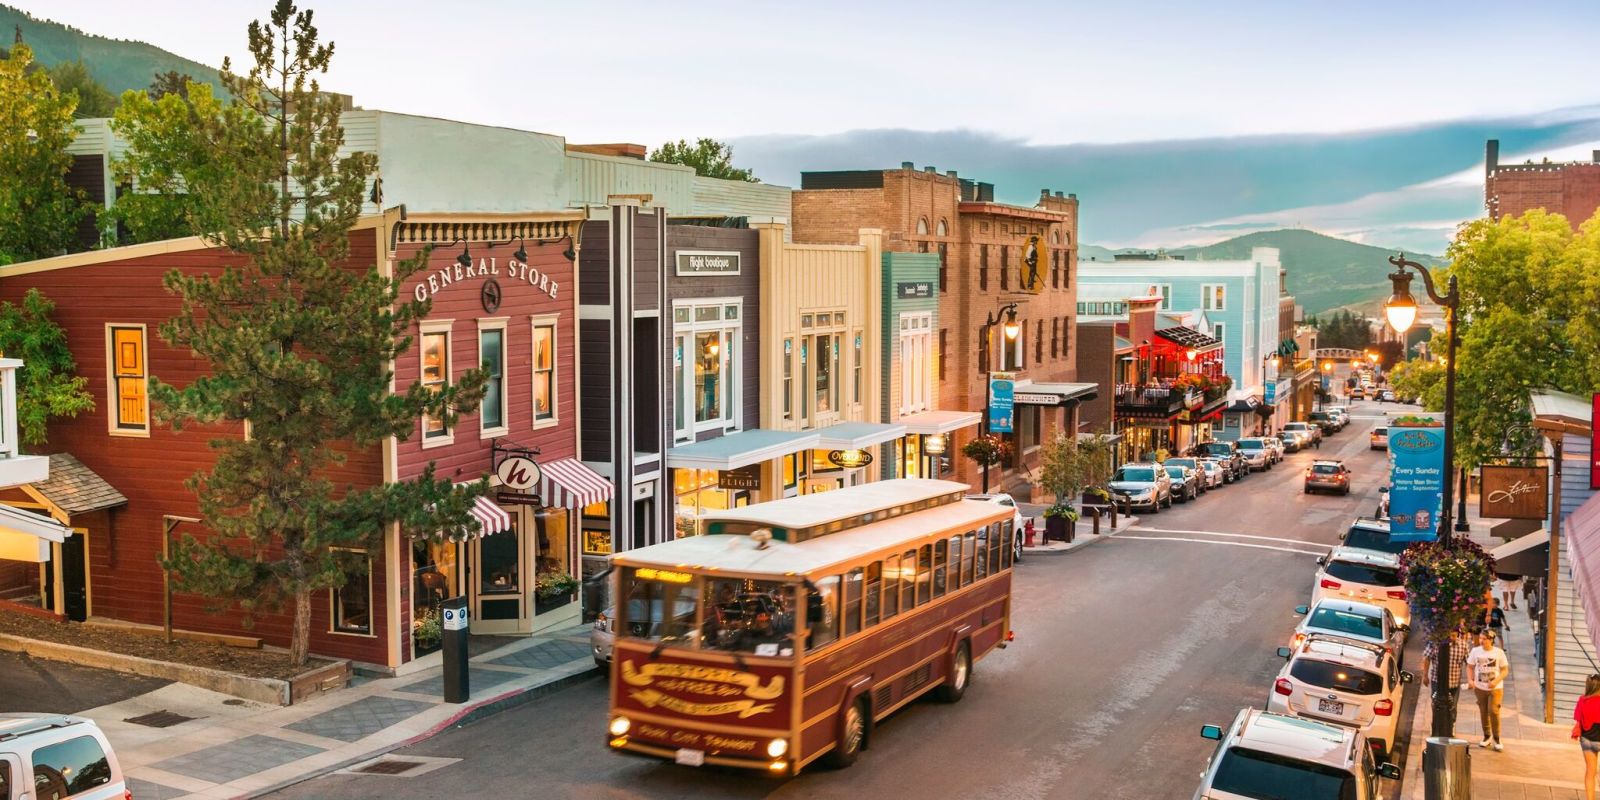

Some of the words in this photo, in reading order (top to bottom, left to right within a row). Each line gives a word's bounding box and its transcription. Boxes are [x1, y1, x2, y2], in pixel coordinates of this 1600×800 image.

[705, 256, 729, 271] boutique
[415, 257, 499, 302] GENERAL
[508, 260, 559, 299] STORE
[1395, 466, 1413, 475] Every
[1415, 467, 1440, 475] Sunday
[720, 479, 759, 488] FLIGHT
